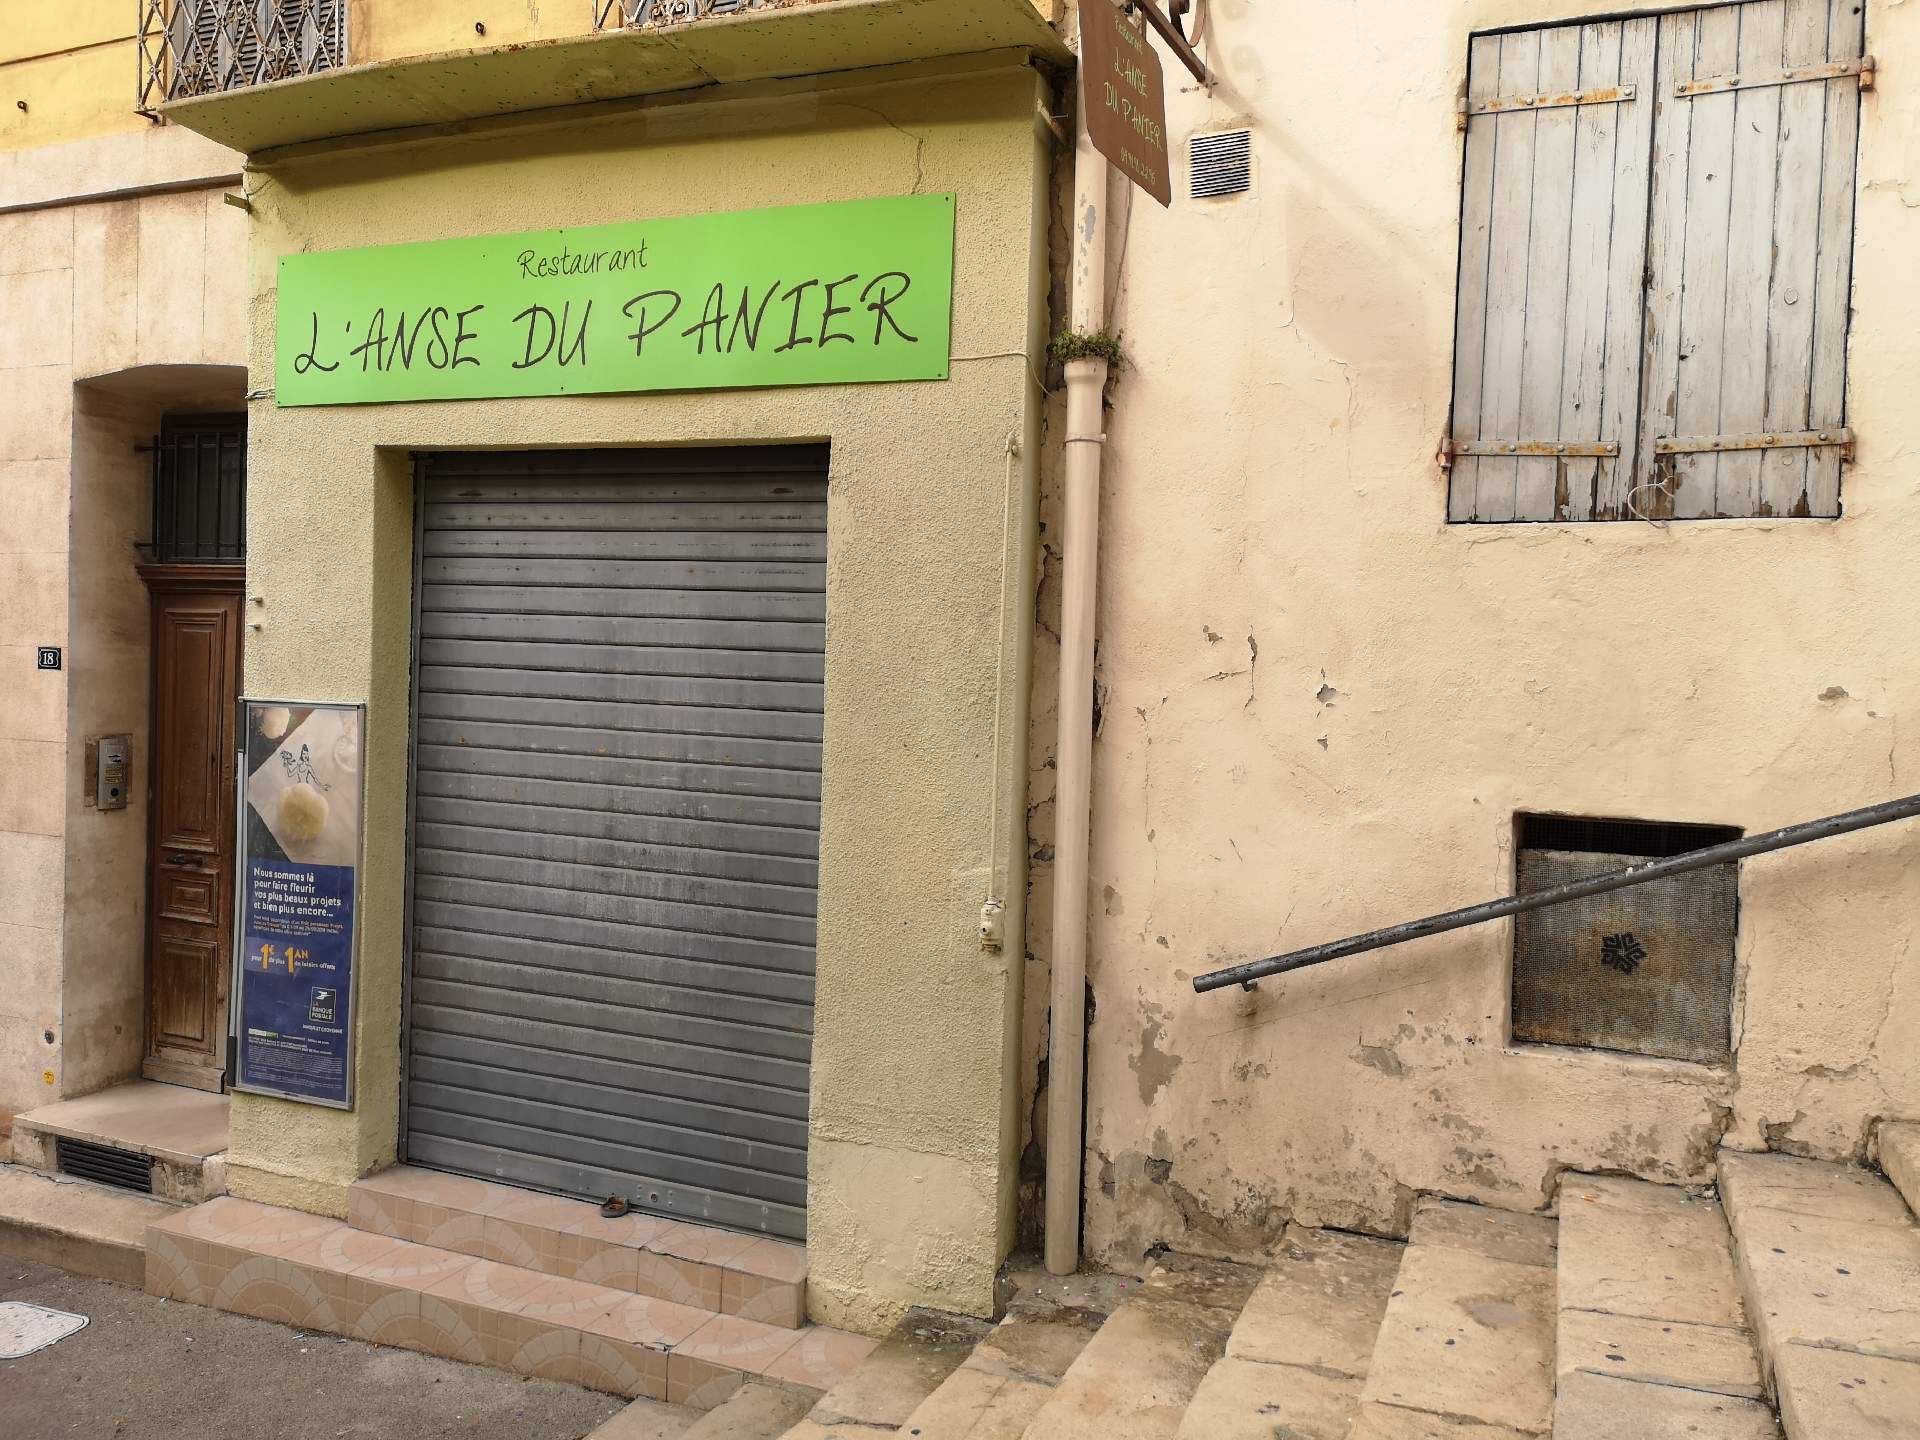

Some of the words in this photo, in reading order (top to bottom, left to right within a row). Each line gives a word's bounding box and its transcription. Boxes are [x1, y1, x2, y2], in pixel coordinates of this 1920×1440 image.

[1114, 47, 1148, 98] L'ANSE
[1104, 81, 1119, 114] DU
[1122, 98, 1163, 152] PANIER
[516, 238, 649, 279] Restaurant
[294, 304, 485, 375] L'ANSE
[511, 300, 593, 368] DU
[622, 271, 918, 356] PANIER
[43, 652, 54, 665] 18
[254, 867, 273, 878] Nous
[274, 870, 305, 882] sommes
[306, 872, 315, 883] là
[254, 880, 271, 889] pour
[272, 881, 288, 891] faire
[290, 883, 316, 894] fleurir
[254, 891, 267, 899] vos
[268, 891, 283, 902] plus
[284, 894, 308, 905] beaux
[310, 896, 342, 908] projets
[254, 901, 261, 910] et
[262, 901, 277, 912] bien
[278, 903, 295, 915] plus
[311, 1012, 333, 1020] POSTALE
